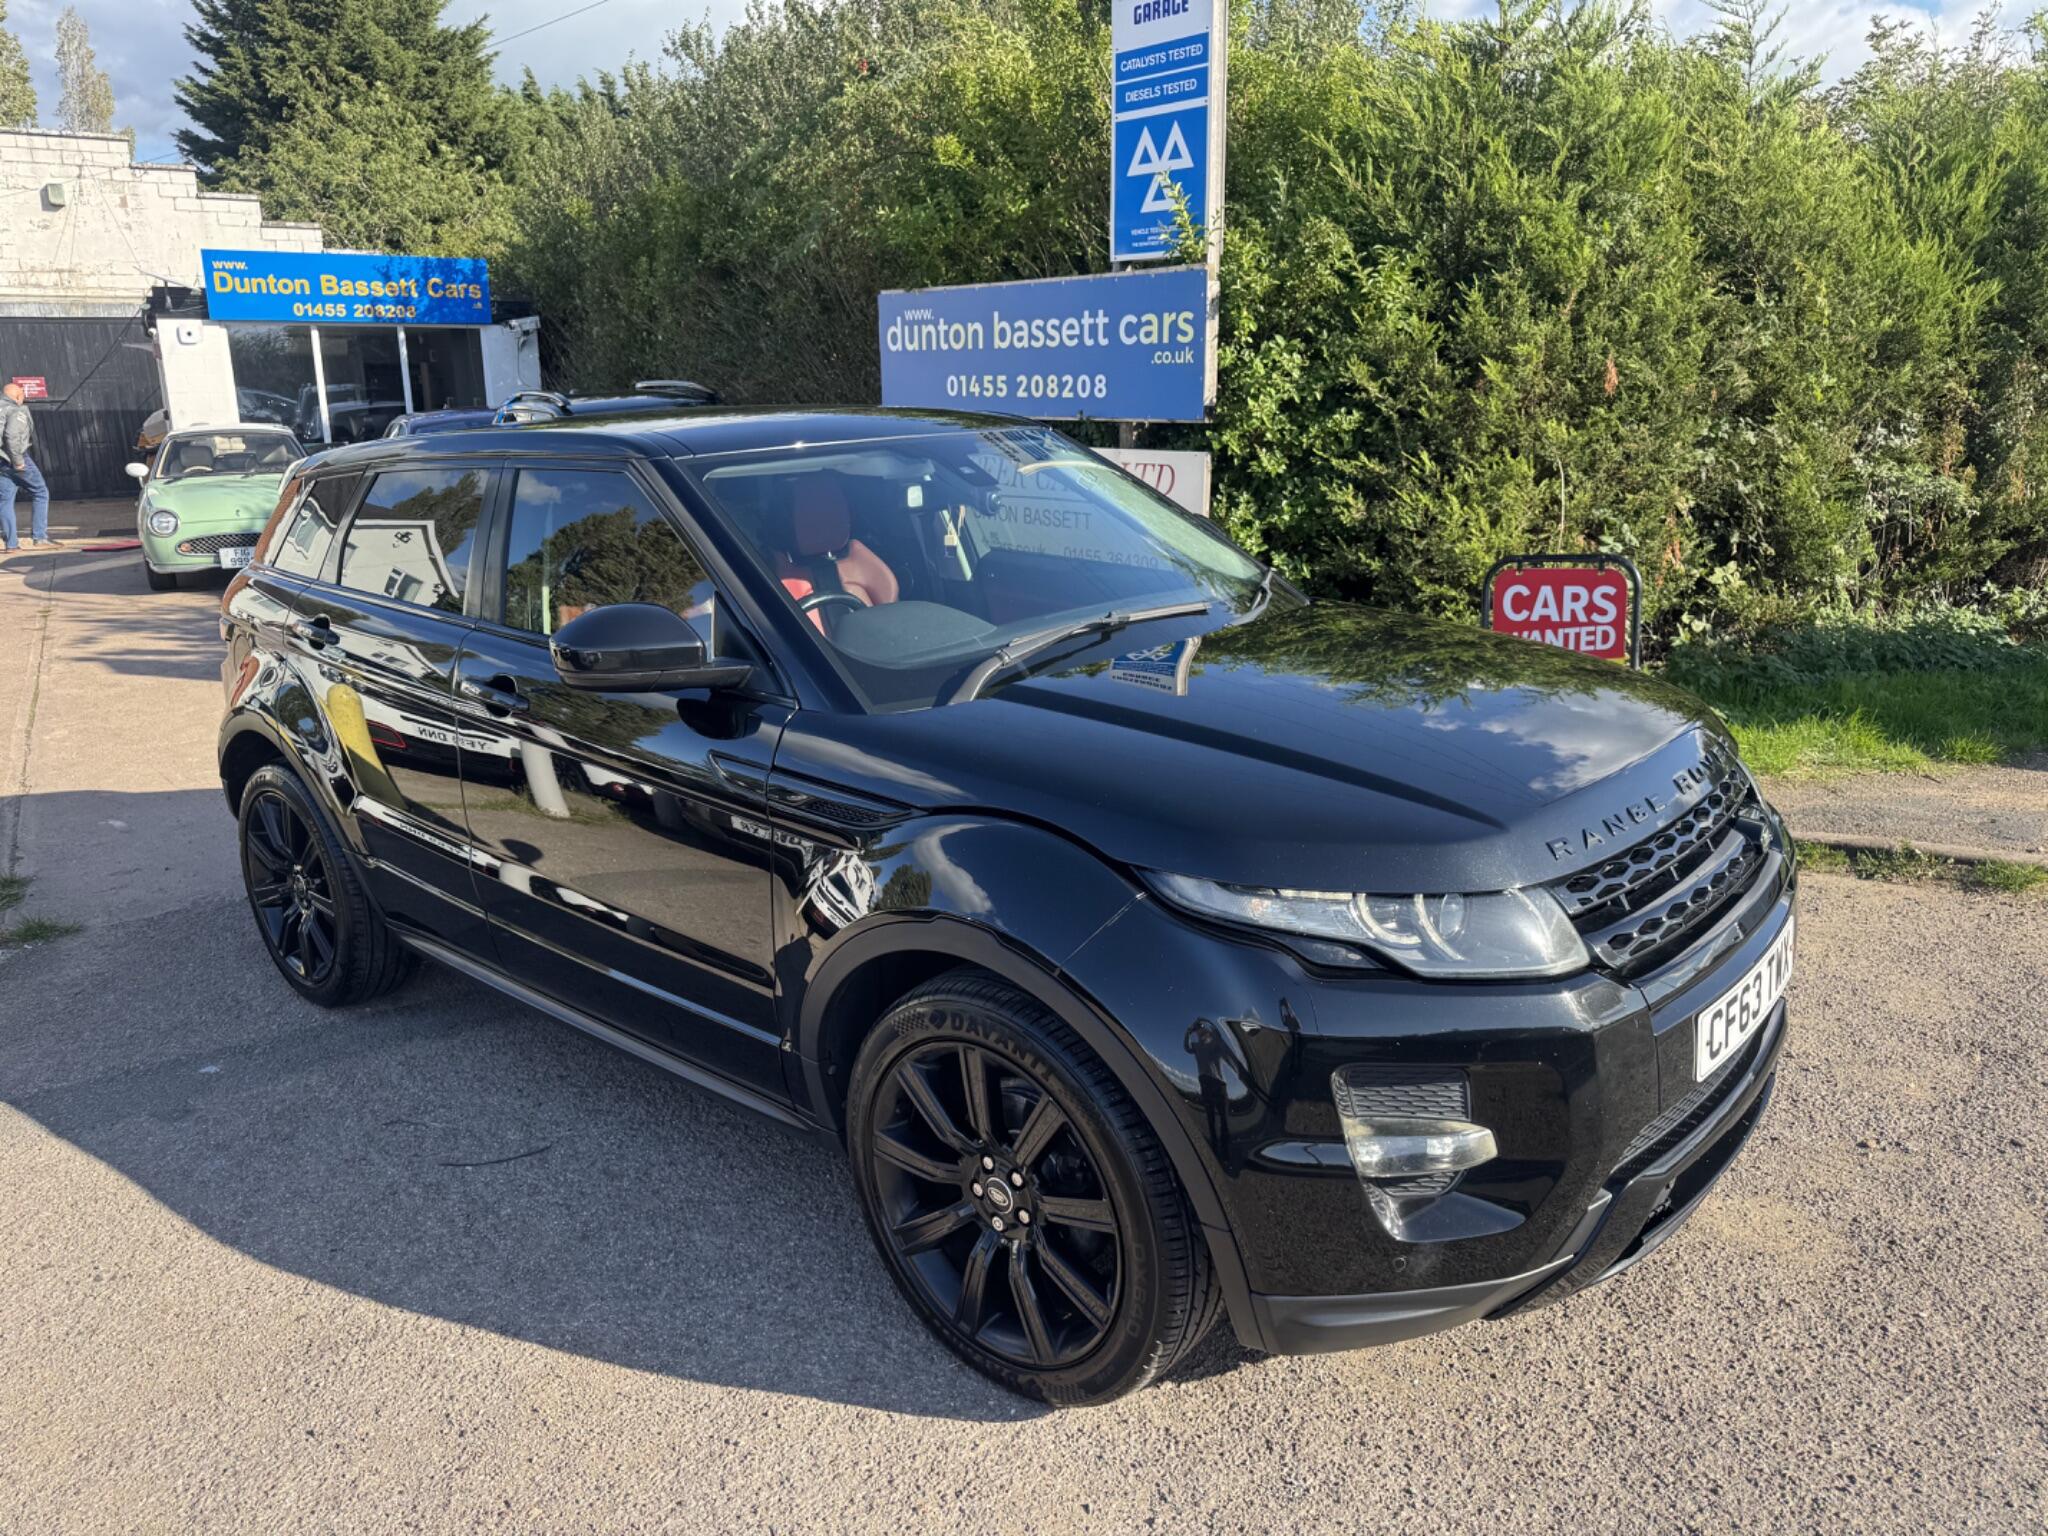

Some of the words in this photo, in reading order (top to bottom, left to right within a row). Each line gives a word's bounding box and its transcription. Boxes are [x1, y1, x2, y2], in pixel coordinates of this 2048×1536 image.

[1133, 0, 1189, 25] GARAGE
[1120, 52, 1167, 72] CATALYSTS
[1168, 43, 1204, 60] TESTED
[1125, 86, 1161, 103] DIESELS
[1162, 78, 1198, 95] TESTED
[212, 260, 248, 270] www.
[213, 271, 310, 295] Dunton
[320, 274, 418, 298] Bassett
[427, 279, 482, 299] Cars
[293, 302, 347, 317] 01455
[353, 303, 417, 318] 208208
[904, 309, 935, 321] www.
[887, 316, 984, 352] dunton
[993, 309, 1110, 350] bassett
[1119, 309, 1195, 346] cars
[1151, 346, 1194, 365] .co.uk
[947, 375, 1008, 398] 01455
[1016, 373, 1108, 399] 208208
[1023, 507, 1093, 530] BASSETT
[1502, 584, 1618, 624] CARS
[1512, 625, 1616, 652] NTED
[1545, 795, 1667, 861] RANGE
[1708, 970, 1762, 1061] CF63
